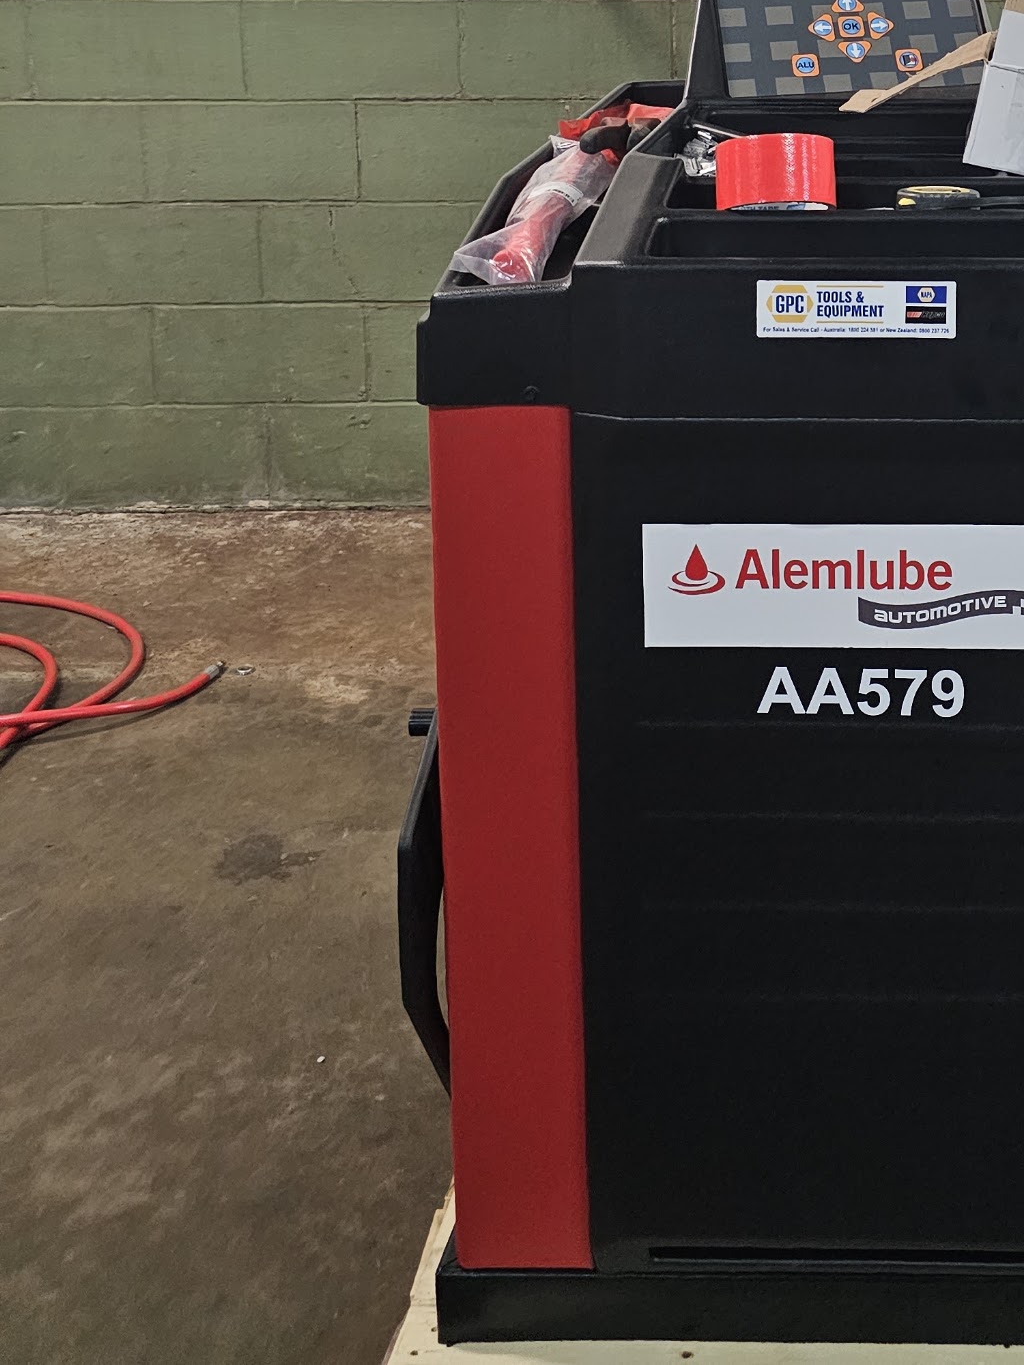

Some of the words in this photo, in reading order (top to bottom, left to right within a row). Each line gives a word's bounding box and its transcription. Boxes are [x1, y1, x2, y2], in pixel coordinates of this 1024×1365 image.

[843, 22, 860, 31] OK
[796, 60, 815, 69] ALU
[816, 291, 852, 303] TOOLS
[856, 291, 865, 303] &
[775, 294, 805, 314] GPC
[816, 305, 885, 318] EQUIPMENT
[734, 548, 953, 591] Alemlube
[756, 666, 965, 718] AA579
